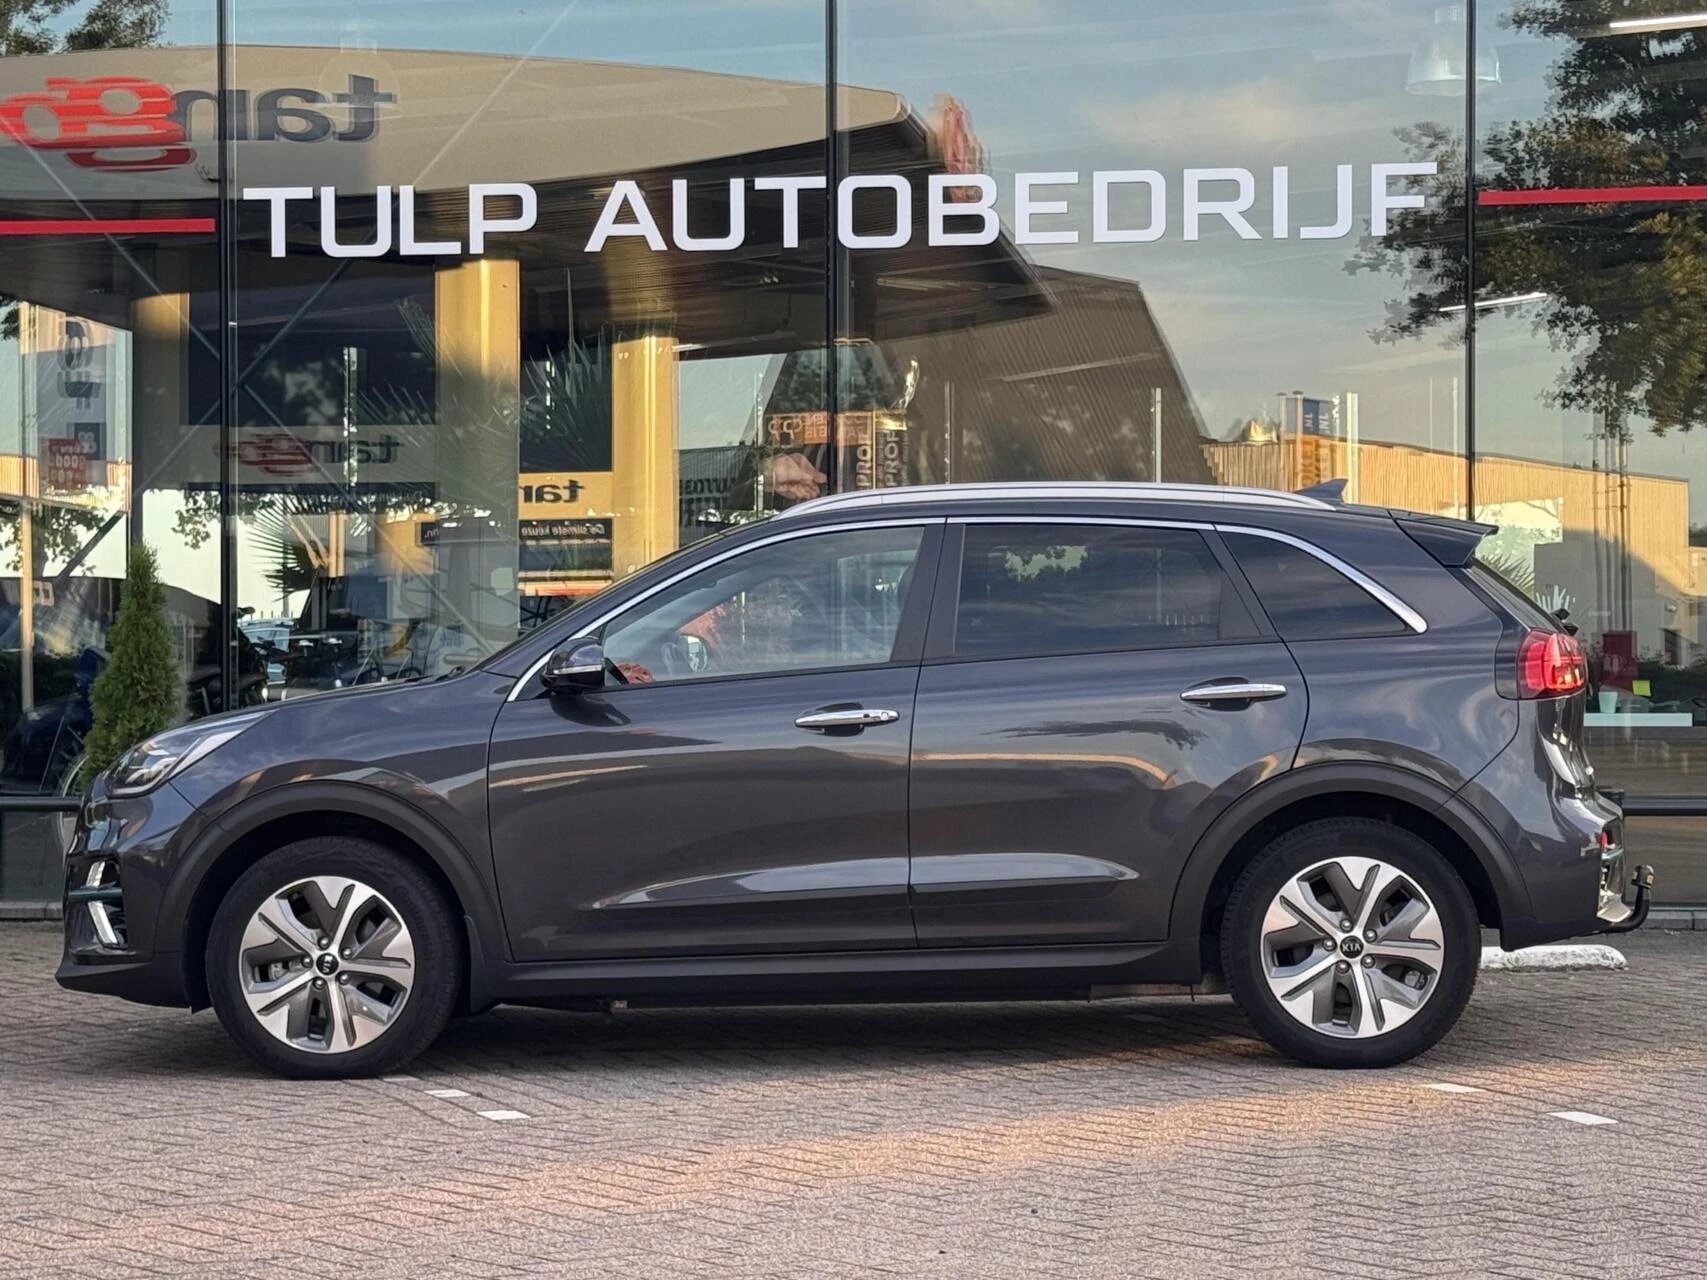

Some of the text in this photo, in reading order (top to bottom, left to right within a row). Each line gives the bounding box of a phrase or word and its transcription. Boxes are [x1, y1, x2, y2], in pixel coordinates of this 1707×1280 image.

[243, 161, 1439, 258] TULP AUTOBEDRIJF
[1341, 943, 1361, 953] KIA
